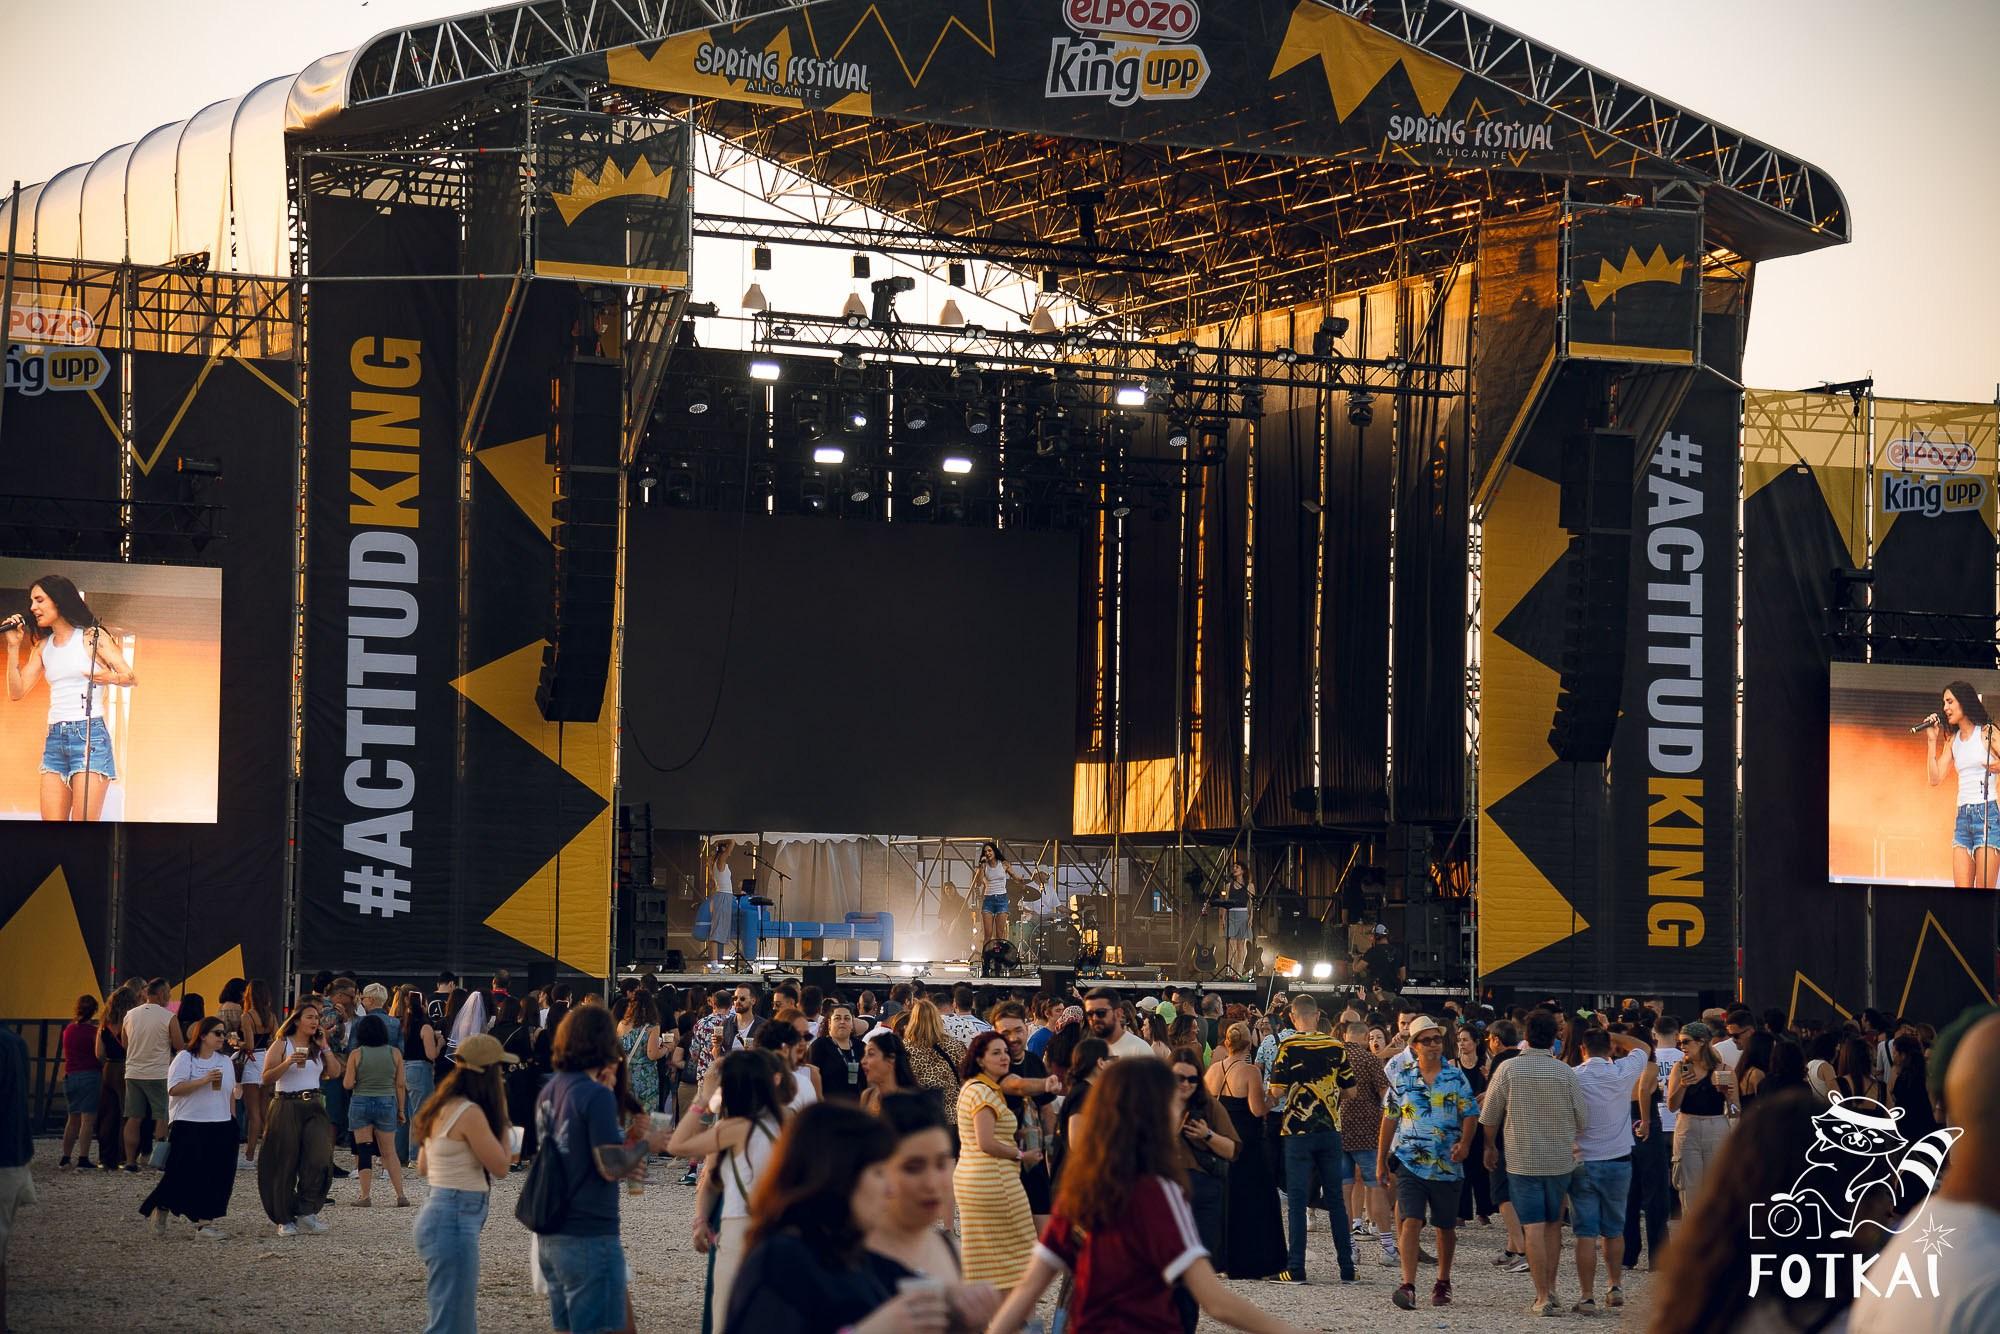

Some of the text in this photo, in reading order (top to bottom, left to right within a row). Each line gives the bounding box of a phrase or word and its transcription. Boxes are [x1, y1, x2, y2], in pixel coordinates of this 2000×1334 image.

[747, 82, 821, 99] ALICANTE
[1436, 147, 1507, 160] ALICANTE
[8, 310, 89, 338] POZO
[6, 356, 45, 392] ng
